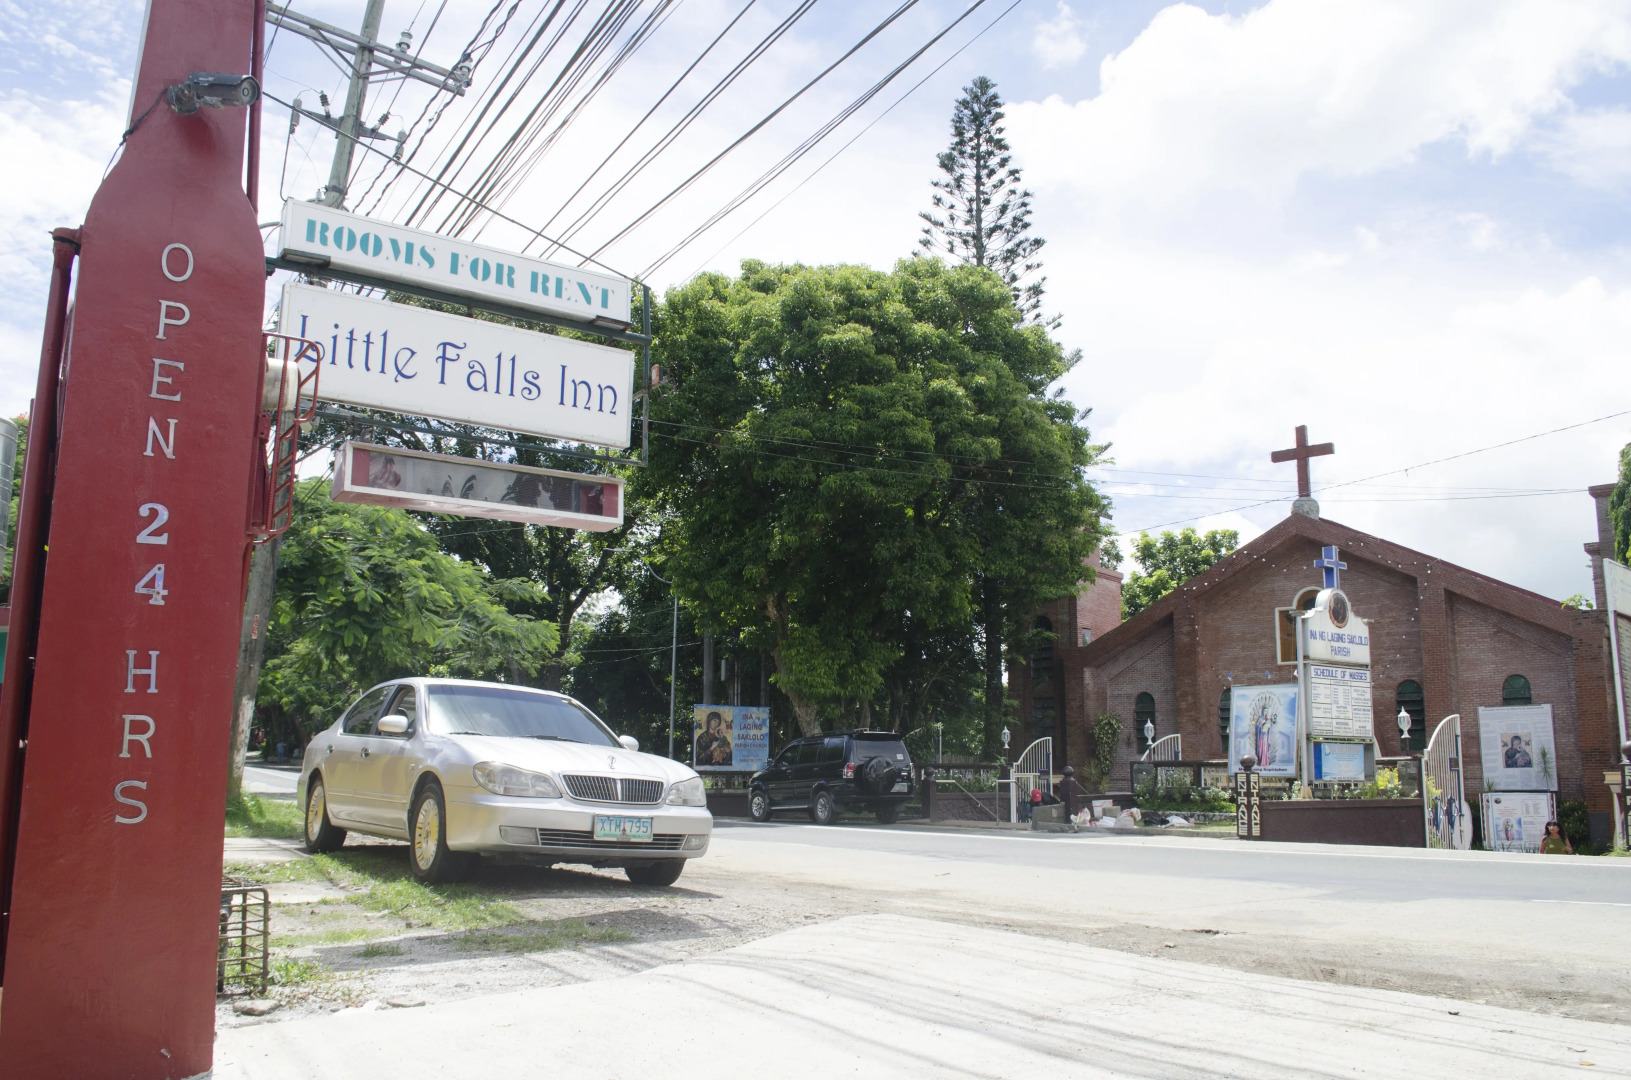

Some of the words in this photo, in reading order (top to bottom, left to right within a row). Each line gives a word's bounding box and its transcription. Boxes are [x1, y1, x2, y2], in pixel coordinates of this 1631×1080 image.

[306, 218, 437, 270] ROOMS
[450, 251, 517, 290] FOR
[530, 270, 616, 311] RENT
[142, 242, 194, 461] OPEN
[296, 314, 418, 384] Little
[436, 340, 542, 402] Falls
[559, 363, 619, 417] Inn
[134, 502, 170, 606] 24
[1313, 667, 1339, 679] SCHEDULE
[1340, 670, 1347, 679] OF
[1349, 671, 1368, 681] MASSES
[1330, 645, 1351, 657] PARISH
[113, 649, 160, 825] HRS
[737, 733, 765, 741] SAKLOLO
[739, 723, 763, 731] LAGING
[628, 819, 649, 834] 795
[1238, 774, 1248, 836] ENTRANCE
[1251, 774, 1260, 836] ENTRANCE
